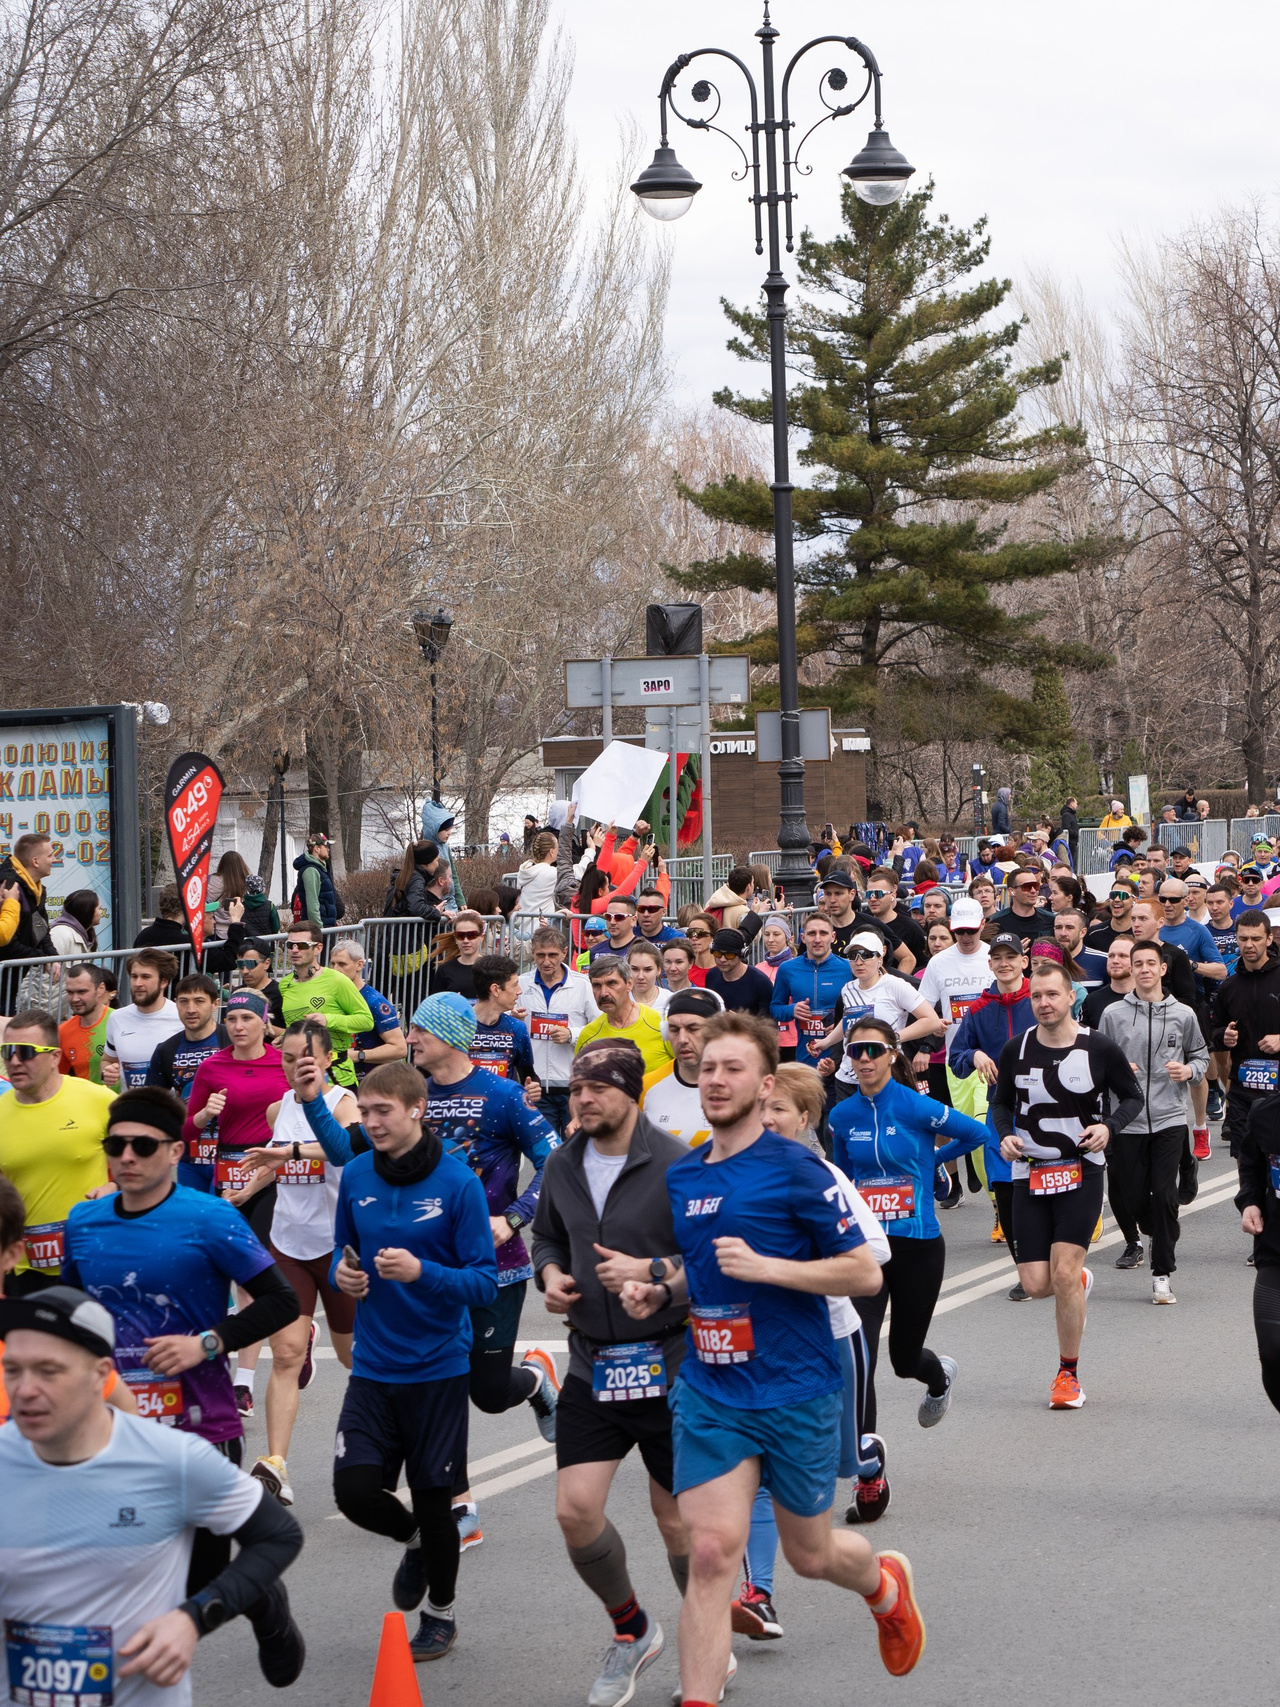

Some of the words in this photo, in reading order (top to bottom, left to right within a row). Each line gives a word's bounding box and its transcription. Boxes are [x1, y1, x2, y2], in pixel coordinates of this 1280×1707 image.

[643, 679, 671, 693] ЗАРО
[0, 740, 109, 767] ОЛЮЦИЯ
[171, 765, 198, 797] GARMIN
[172, 782, 209, 832] 0:49
[944, 976, 983, 988] CRAFT
[470, 1040, 514, 1049] ОСМОС
[1245, 1070, 1270, 1083] 2292
[283, 1159, 310, 1175] 1587
[1040, 1171, 1071, 1188] 1558
[867, 1193, 900, 1211] 1762
[32, 1240, 61, 1258] 1771
[697, 1328, 734, 1351] 1182
[605, 1364, 651, 1389] 2025
[137, 1392, 165, 1414] 54
[21, 1655, 89, 1692] 2097
